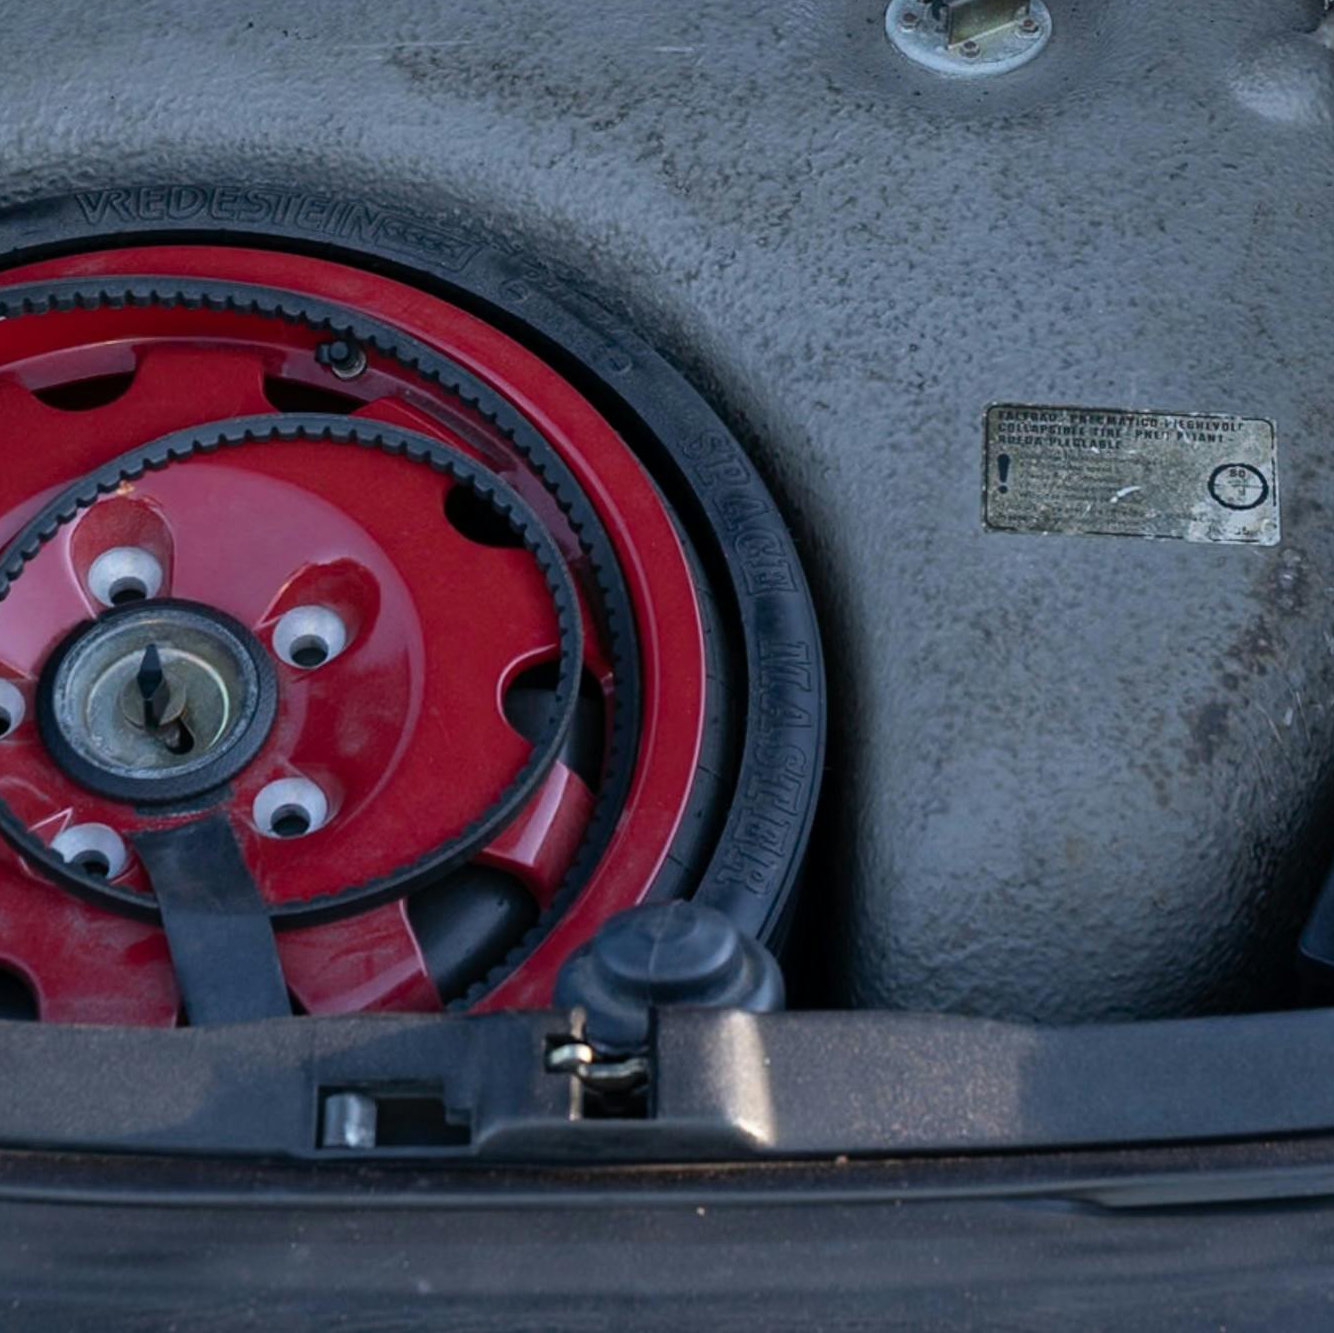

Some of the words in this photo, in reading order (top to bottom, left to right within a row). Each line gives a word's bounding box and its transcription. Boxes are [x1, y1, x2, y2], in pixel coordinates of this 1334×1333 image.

[75, 184, 392, 246] VREDESTEIN
[677, 428, 799, 598] SPACE
[715, 638, 814, 897] MASTER
